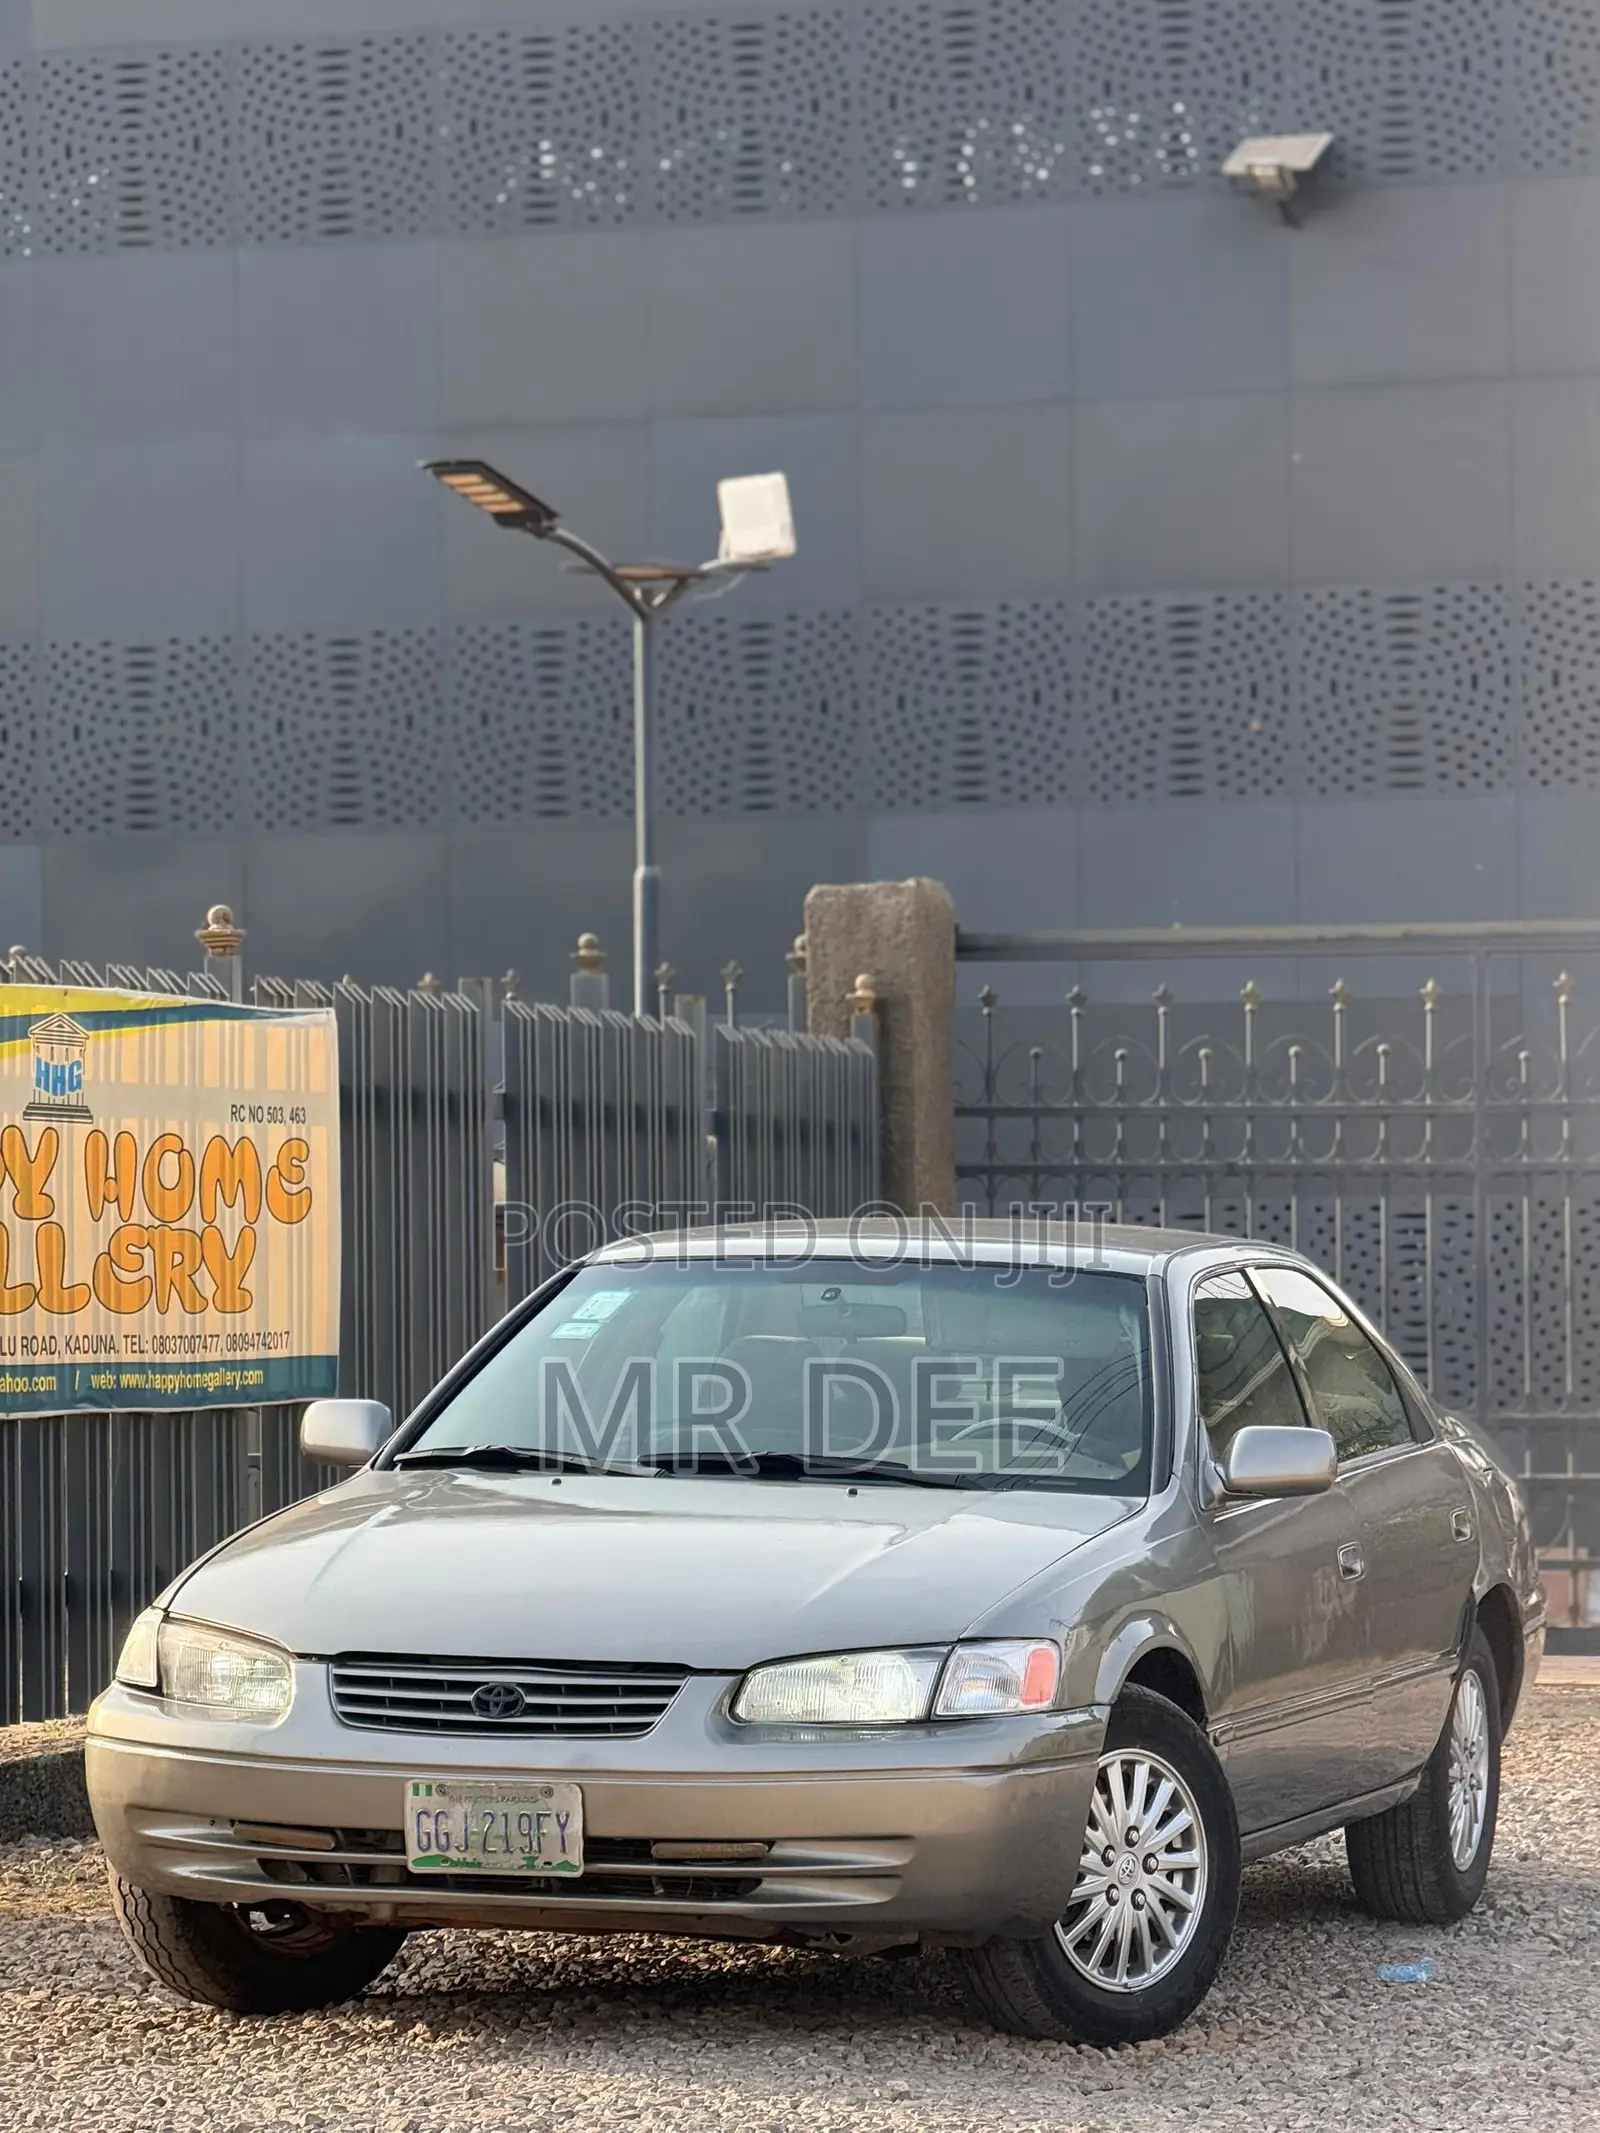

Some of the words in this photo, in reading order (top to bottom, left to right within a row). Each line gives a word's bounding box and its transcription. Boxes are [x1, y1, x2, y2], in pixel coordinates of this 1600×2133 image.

[35, 1055, 82, 1097] HHG
[230, 1103, 246, 1123] RC
[248, 1104, 264, 1124] NO
[266, 1105, 287, 1126] 503,
[289, 1106, 307, 1124] 463
[0, 1124, 60, 1221] Y
[84, 1129, 312, 1225] HOME
[20, 1335, 61, 1359] ROAD,
[64, 1334, 120, 1355] KADUNA.
[123, 1334, 149, 1354] TEL:
[151, 1334, 223, 1356] 08037007477,
[225, 1330, 290, 1352] 08094742017
[90, 1370, 117, 1390] web:
[119, 1367, 264, 1394] www.happyhomegallery.com
